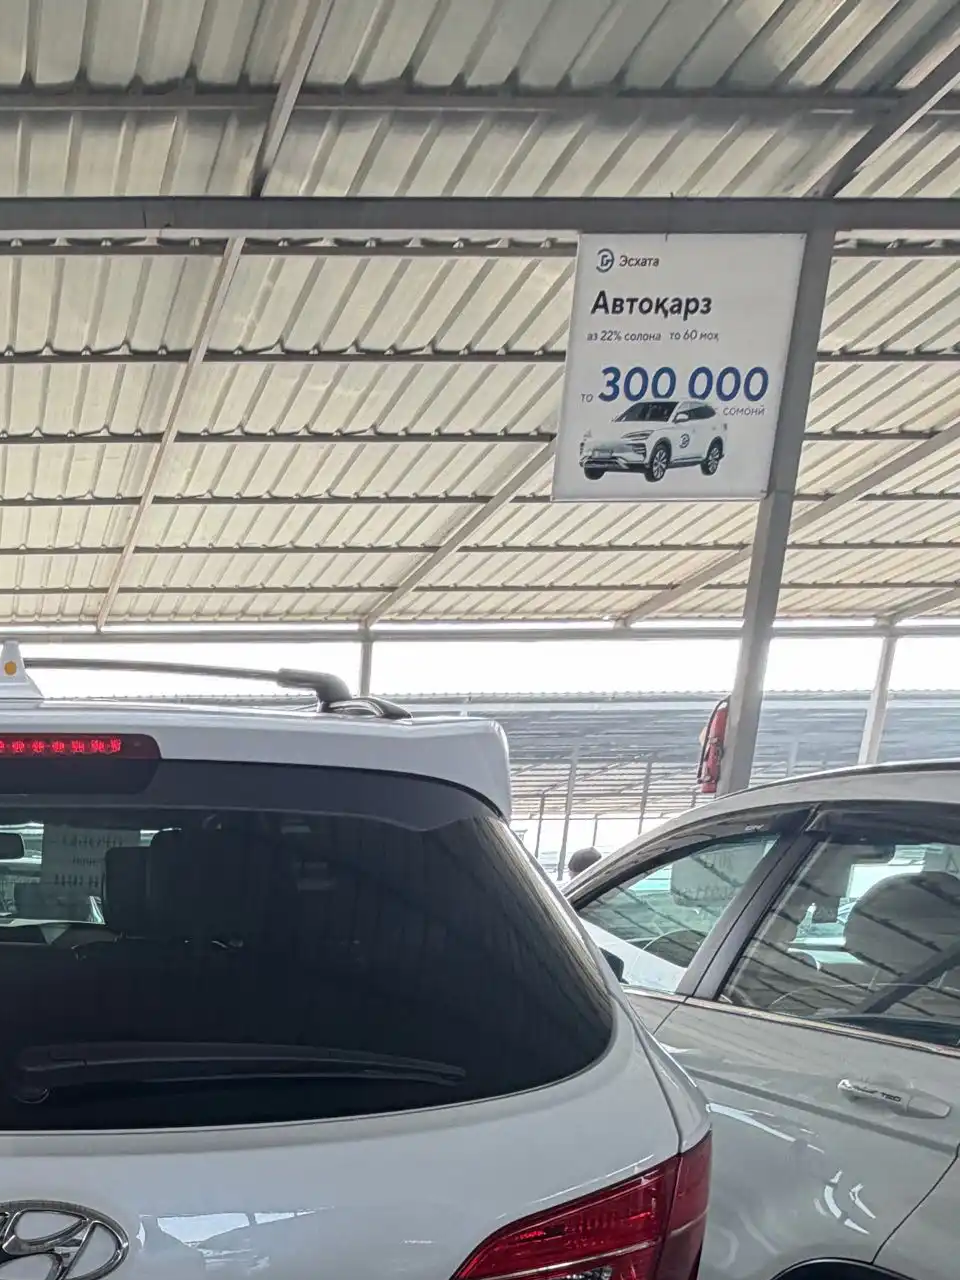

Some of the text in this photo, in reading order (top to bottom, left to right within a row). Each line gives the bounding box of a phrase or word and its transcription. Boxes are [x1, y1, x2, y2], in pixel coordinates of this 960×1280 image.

[619, 255, 659, 267] Эсхата
[590, 290, 712, 321] Автоқарз
[587, 332, 598, 341] аз
[600, 330, 622, 342] 22%
[624, 332, 662, 341] солона
[669, 332, 681, 340] то
[683, 329, 698, 341] 60
[580, 366, 769, 403] то 300 000
